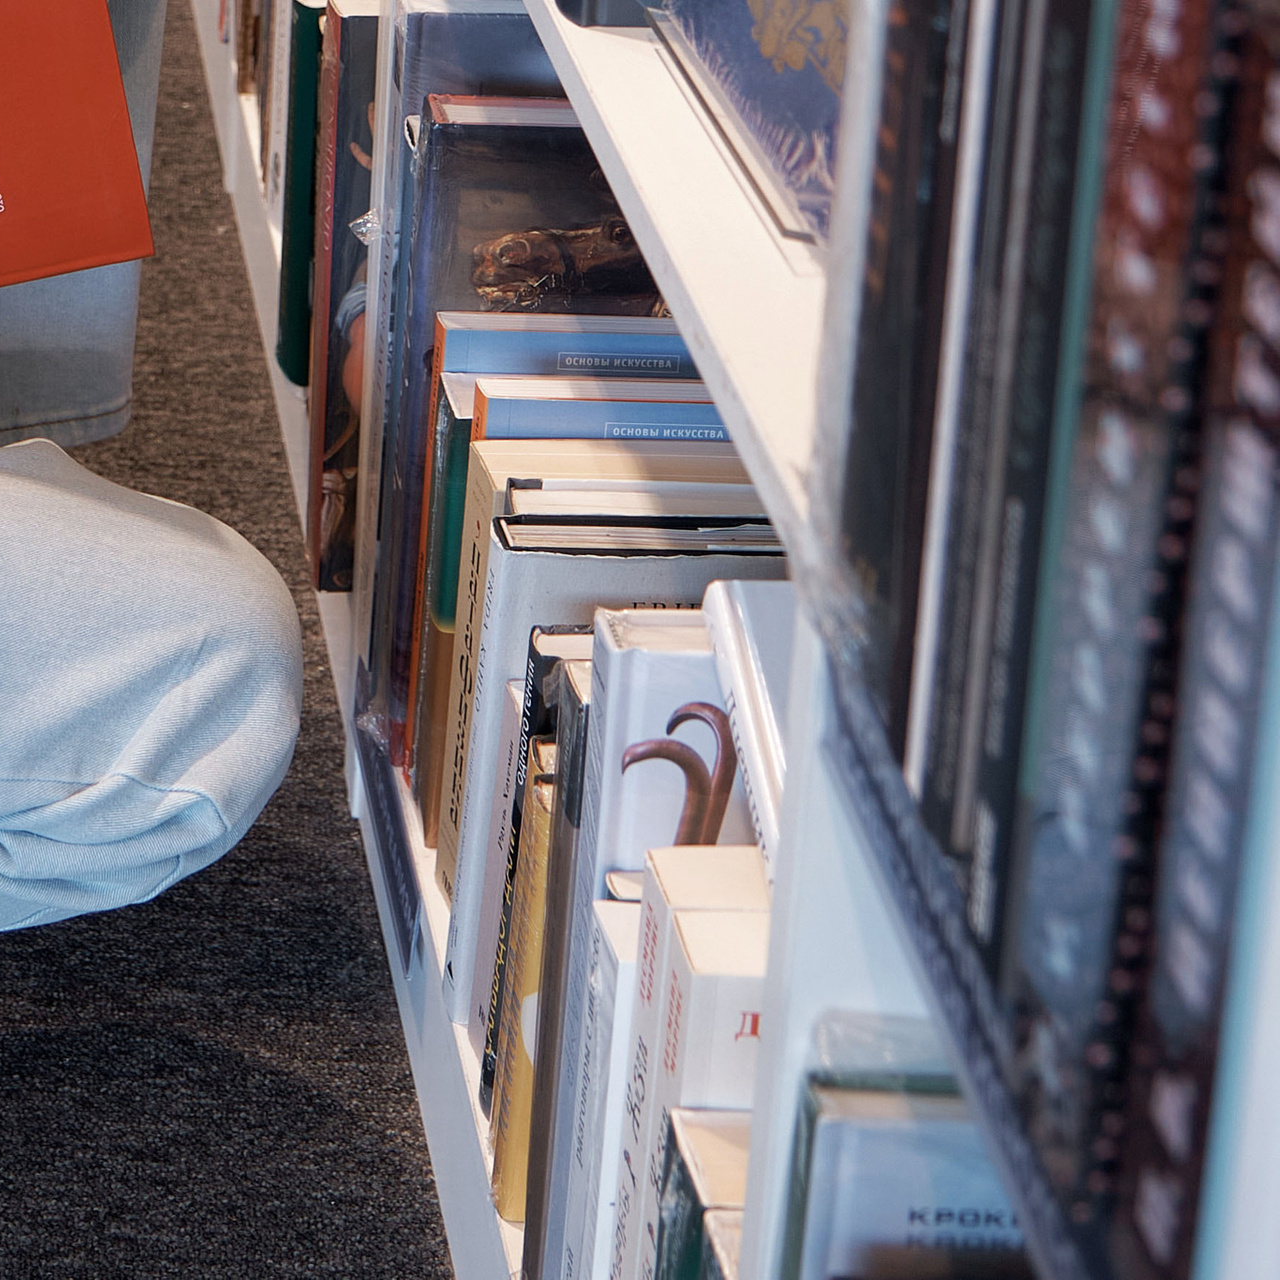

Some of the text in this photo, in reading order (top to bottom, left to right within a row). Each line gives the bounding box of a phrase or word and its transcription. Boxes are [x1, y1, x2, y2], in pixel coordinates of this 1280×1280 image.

[566, 357, 672, 368] ОСНОВЫ ИСКУССТВА
[613, 427, 724, 439] ОСНОВЫ ИСКУССТВА
[517, 710, 531, 785] ОДНОГО
[575, 1042, 592, 1168] разговоры
